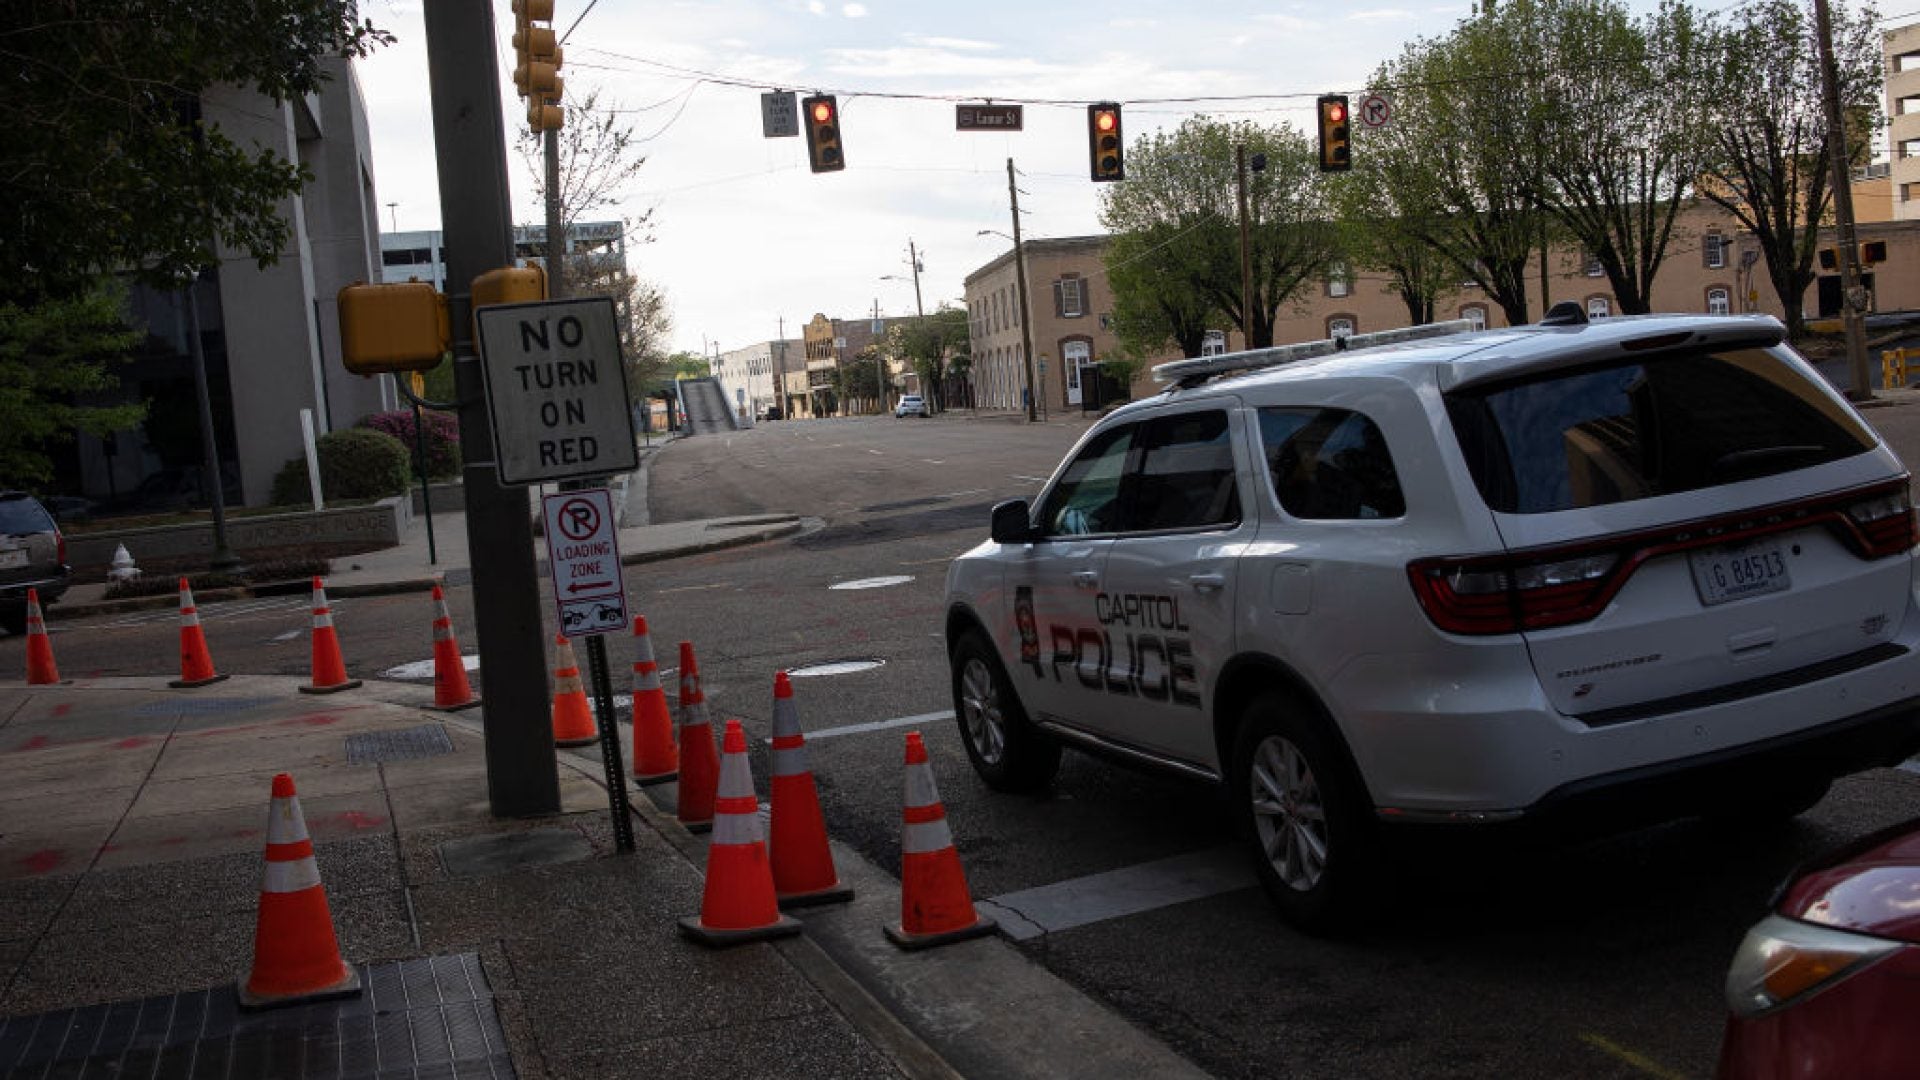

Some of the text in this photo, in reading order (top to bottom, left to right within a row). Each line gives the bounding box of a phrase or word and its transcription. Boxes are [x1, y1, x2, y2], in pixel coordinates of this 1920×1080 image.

[520, 315, 584, 353] NO
[514, 359, 598, 392] TURN
[541, 398, 586, 428] ON
[539, 436, 599, 467] RED
[557, 541, 610, 561] LOADING
[570, 561, 604, 578] ZONE
[1713, 563, 1726, 588] G
[1731, 550, 1784, 583] 84513
[1096, 592, 1190, 632] CAPITOL
[1051, 624, 1204, 711] POLICE
